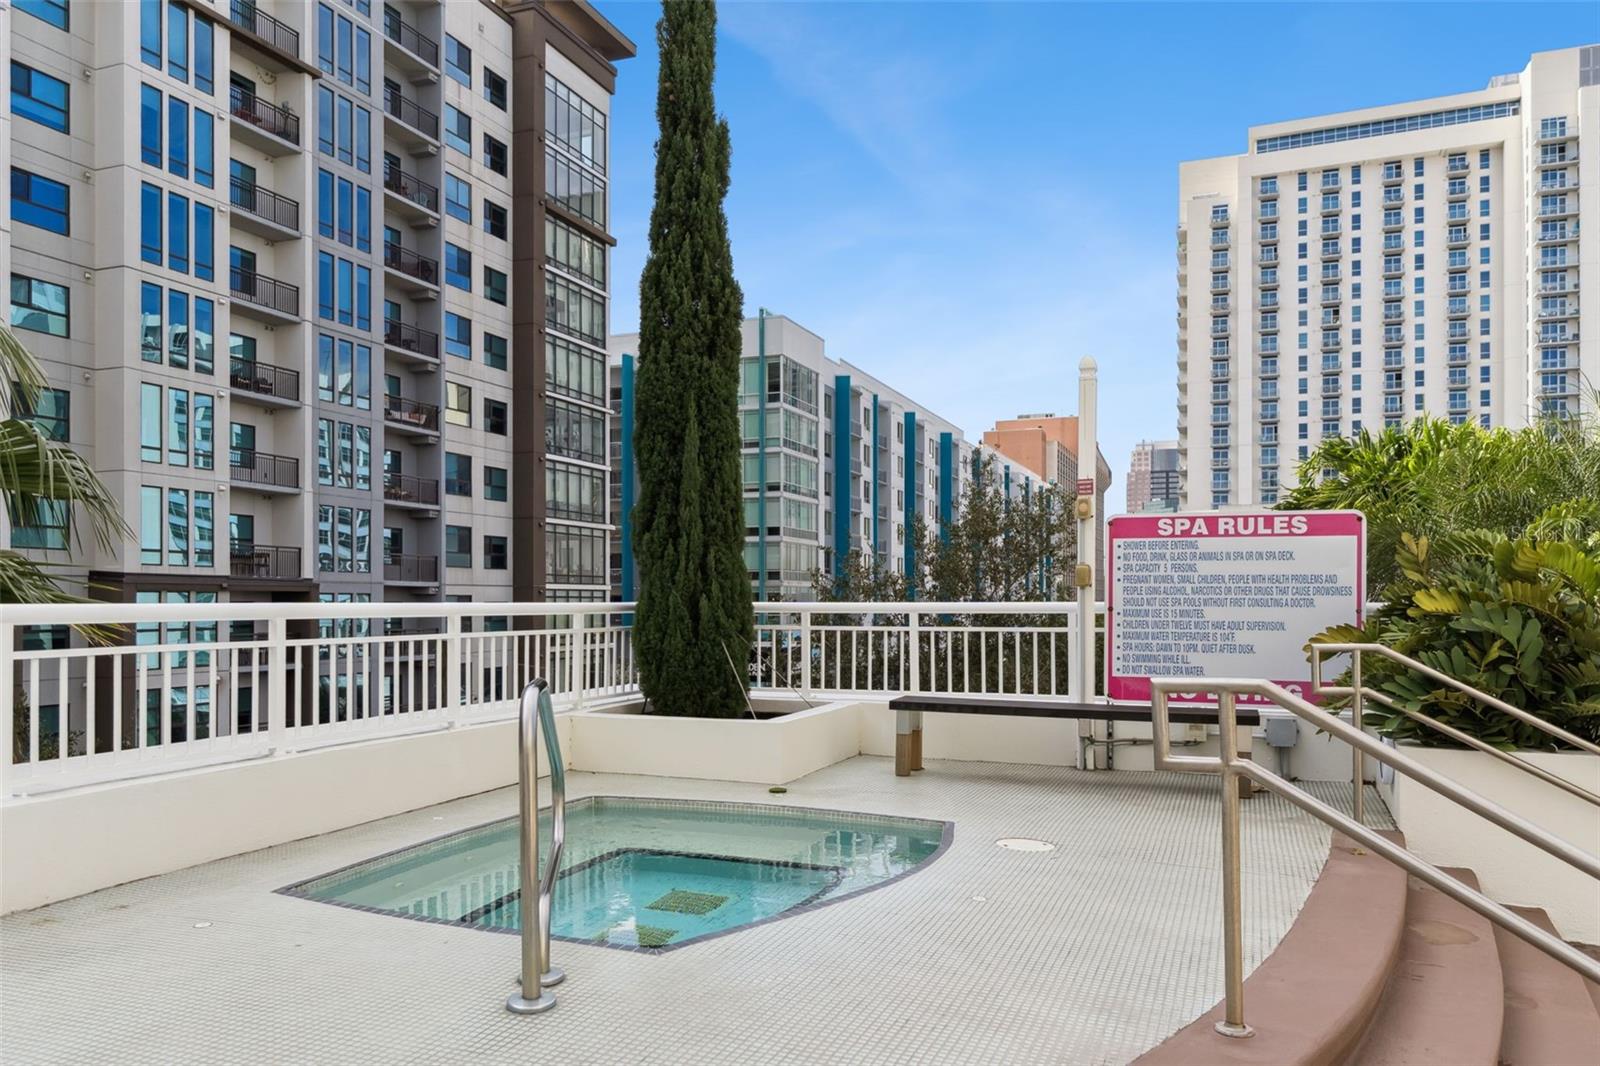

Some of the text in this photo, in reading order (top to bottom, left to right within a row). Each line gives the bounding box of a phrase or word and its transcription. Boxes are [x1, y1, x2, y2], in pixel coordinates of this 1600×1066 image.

[1157, 516, 1308, 536] SPA RULES
[1123, 541, 1146, 550] SHOWER
[1148, 541, 1169, 550] BEFORE
[1123, 552, 1131, 561] NO
[1170, 552, 1188, 561] GLASS
[1189, 552, 1198, 561] OR
[1198, 552, 1224, 560] ANIMALS
[1225, 552, 1231, 560] IN
[1233, 551, 1244, 560] SPA
[1245, 551, 1254, 560] OR
[1255, 551, 1264, 560] ON
[1265, 551, 1277, 560] SPA
[1123, 564, 1134, 572] SPA
[1135, 564, 1160, 572] CAPACITY
[1123, 575, 1152, 584] PREGNANT
[1177, 575, 1196, 584] SMALL
[1228, 575, 1250, 584] PEOPLE
[1251, 574, 1266, 584] WITH
[1268, 574, 1290, 584] HEALTH
[1291, 574, 1324, 584] PROBLEMS
[1324, 574, 1338, 584] AND
[1123, 586, 1144, 595] PEOPLE
[1145, 586, 1162, 595] USING
[1191, 586, 1222, 596] NARCOTICS
[1224, 586, 1232, 596] OR
[1234, 586, 1252, 596] OTHER
[1254, 586, 1274, 596] DRUGS
[1275, 586, 1290, 596] THAT
[1291, 586, 1311, 596] CAUSE
[1312, 586, 1352, 596] DROWSINESS
[1123, 598, 1145, 606] SHOULD
[1146, 598, 1157, 606] NOT
[1158, 598, 1170, 606] USE
[1170, 598, 1182, 606] SPA
[1183, 598, 1202, 606] POOLS
[1202, 598, 1228, 607] WITHOUT
[1230, 598, 1246, 607] FIRST
[1248, 598, 1284, 608] CONSULTING
[1284, 598, 1288, 608] A
[1123, 609, 1150, 618] MAXIMUM
[1151, 609, 1162, 618] USE
[1164, 609, 1169, 618] IS
[1171, 609, 1178, 618] 15
[1122, 620, 1150, 629] CHILDREN
[1151, 620, 1170, 630] UNDER
[1171, 620, 1192, 630] TWELVE
[1194, 621, 1210, 630] MUST
[1211, 621, 1226, 630] HAVE
[1227, 621, 1245, 630] ADULT
[1122, 632, 1150, 640] MAXIMUM
[1151, 632, 1170, 640] WATER
[1171, 632, 1211, 641] TEMPERATURE
[1212, 632, 1218, 641] IS
[1122, 643, 1132, 652] SPA
[1156, 643, 1172, 652] DAWN
[1174, 644, 1181, 652] TO
[1201, 644, 1218, 654] QUIET
[1218, 644, 1238, 654] AFTER
[1122, 654, 1130, 663] NO
[1132, 654, 1161, 663] SWIMMING
[1162, 655, 1180, 664] WHILE
[1122, 665, 1130, 674] DO
[1132, 666, 1143, 674] NOT
[1144, 666, 1172, 674] SWALLOW
[1172, 666, 1184, 674] SPA
